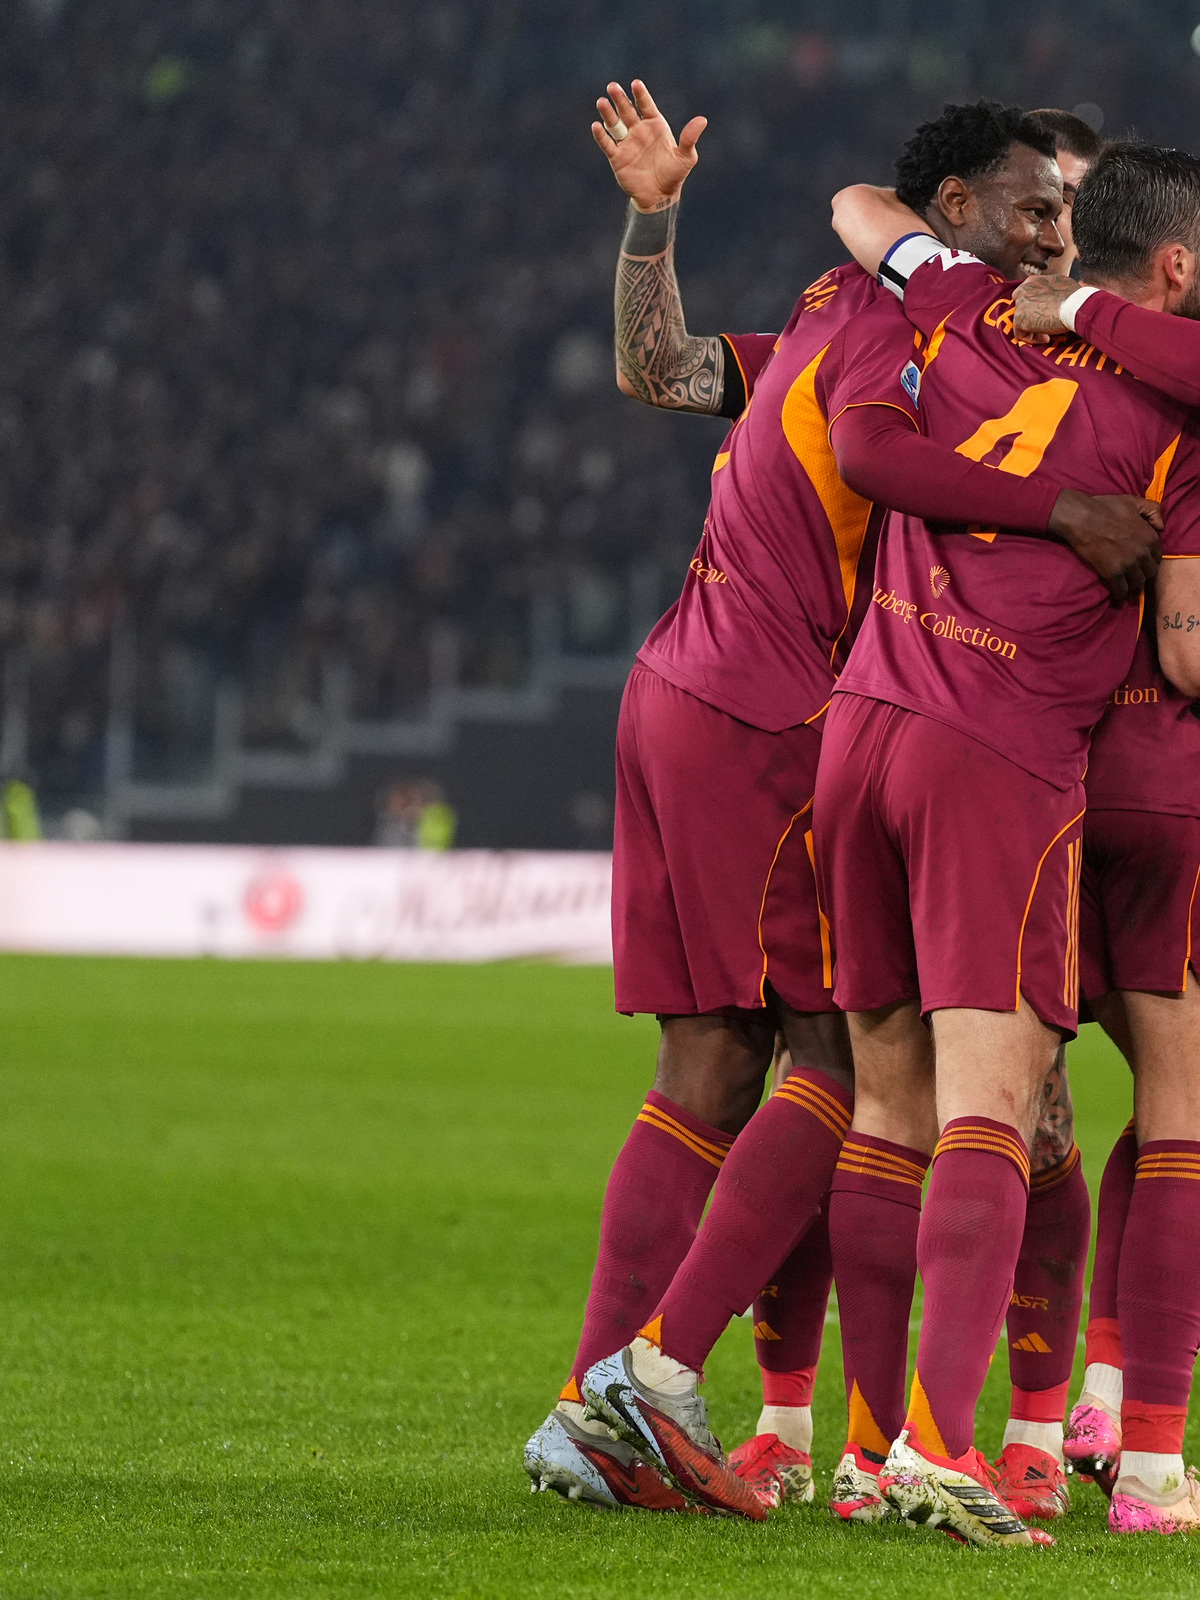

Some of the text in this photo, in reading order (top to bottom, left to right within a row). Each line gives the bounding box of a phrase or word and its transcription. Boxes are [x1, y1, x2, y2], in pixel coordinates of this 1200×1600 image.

[872, 580, 1018, 660] uberge Collection
[1010, 1293, 1049, 1311] ASR
